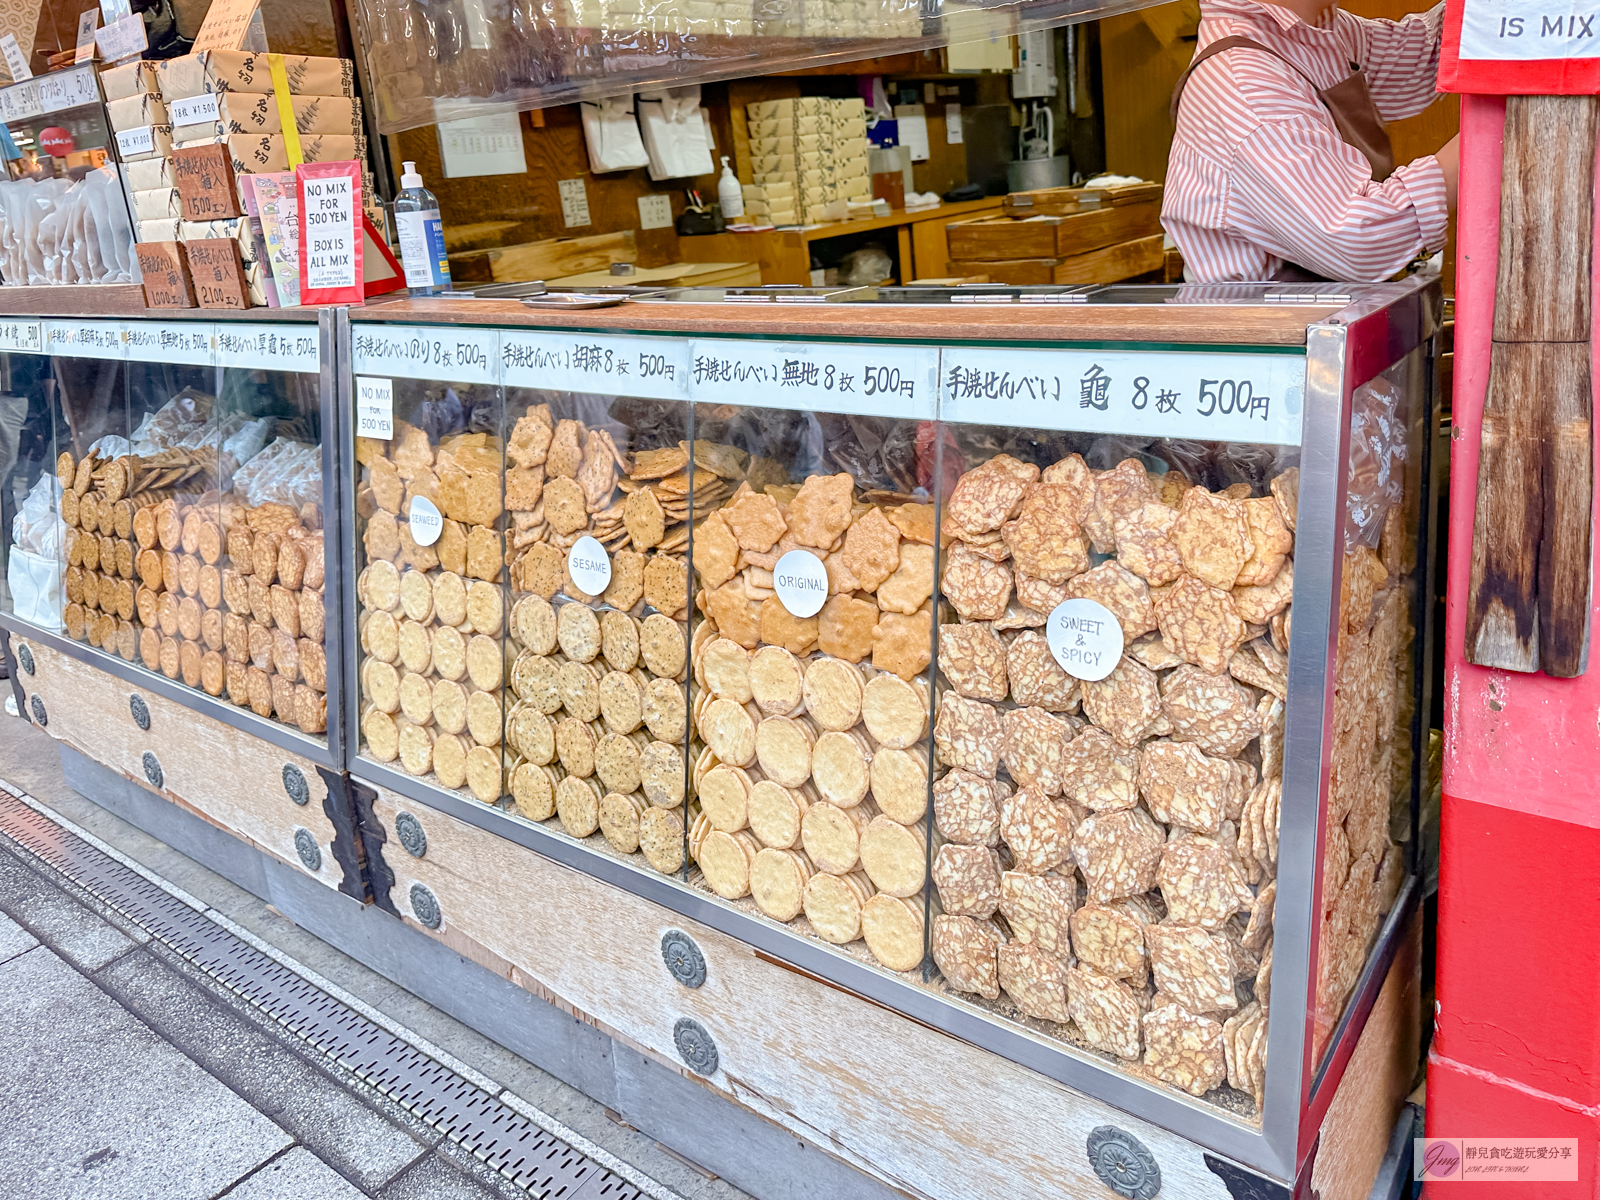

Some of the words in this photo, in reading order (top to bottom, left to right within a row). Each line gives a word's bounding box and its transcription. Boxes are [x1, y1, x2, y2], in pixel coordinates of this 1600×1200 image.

[1499, 16, 1525, 38] IS
[1540, 14, 1595, 39] MIX
[174, 106, 189, 118] 18枚
[307, 184, 322, 197] NO
[326, 182, 347, 195] MIX
[320, 198, 339, 210] FOR
[309, 213, 328, 225] 500
[329, 210, 347, 223] YEN
[314, 239, 333, 252] BOX
[335, 238, 344, 250] IS
[310, 256, 326, 269] ALL
[329, 254, 349, 267] MIX
[639, 352, 675, 381] 500円
[863, 365, 915, 399] 500円
[361, 386, 373, 399] NO
[375, 388, 391, 400] MIX
[946, 365, 1060, 401] 手焼せんべい
[1197, 378, 1270, 421] 500円
[361, 418, 376, 430] 500
[377, 420, 391, 431] YEN
[411, 513, 440, 527] SEAWEED
[572, 557, 607, 574] SESAME
[778, 575, 825, 592] ORIGINAL
[1060, 616, 1105, 636] SWEET
[1075, 633, 1087, 647] &
[1061, 646, 1102, 667] SPICY
